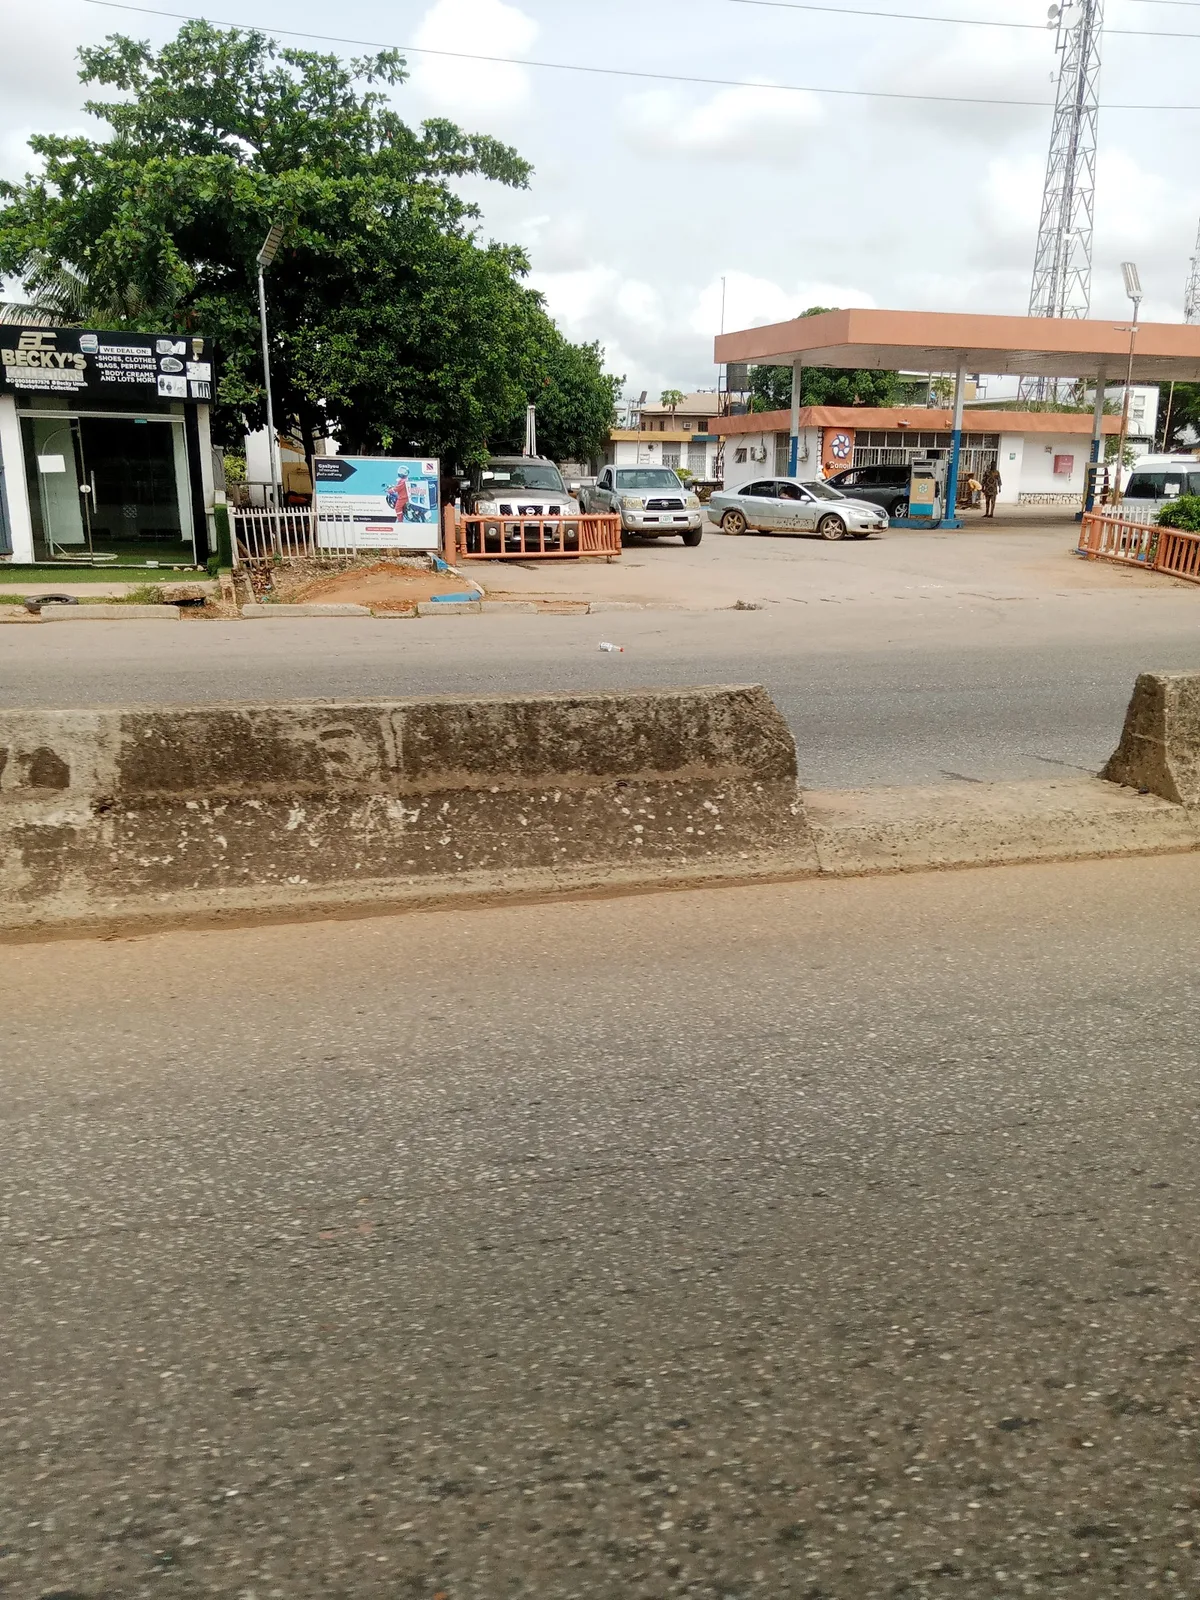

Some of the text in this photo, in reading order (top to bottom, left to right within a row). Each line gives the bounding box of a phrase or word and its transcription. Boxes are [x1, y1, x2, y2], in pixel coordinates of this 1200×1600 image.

[1, 349, 87, 370] BECKY'S
[98, 355, 156, 364] SHOES, CLOTHES
[7, 367, 83, 381] COLLECTIONS
